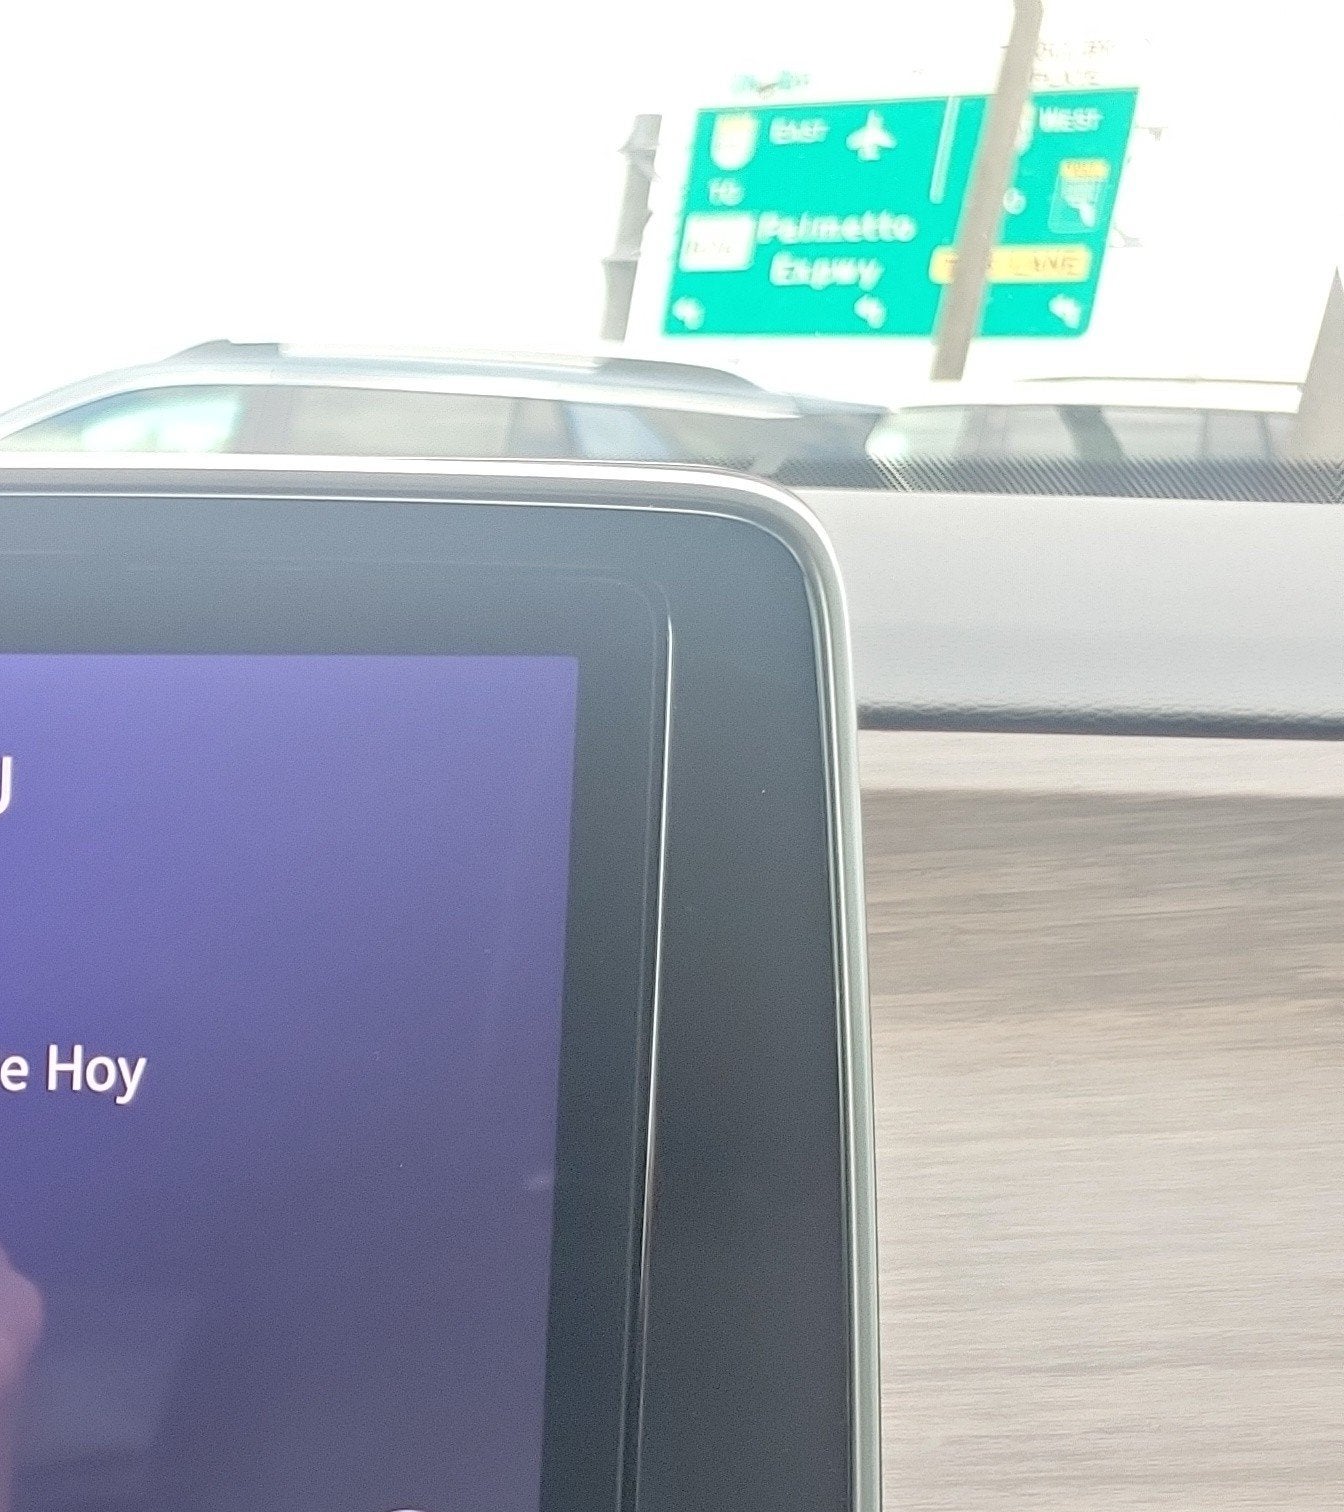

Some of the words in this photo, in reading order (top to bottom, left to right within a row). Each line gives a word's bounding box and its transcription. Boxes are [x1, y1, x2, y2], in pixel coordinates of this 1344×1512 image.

[756, 210, 916, 244] Palmetto
[769, 251, 883, 291] Expwy
[47, 1044, 147, 1104] Hoy
